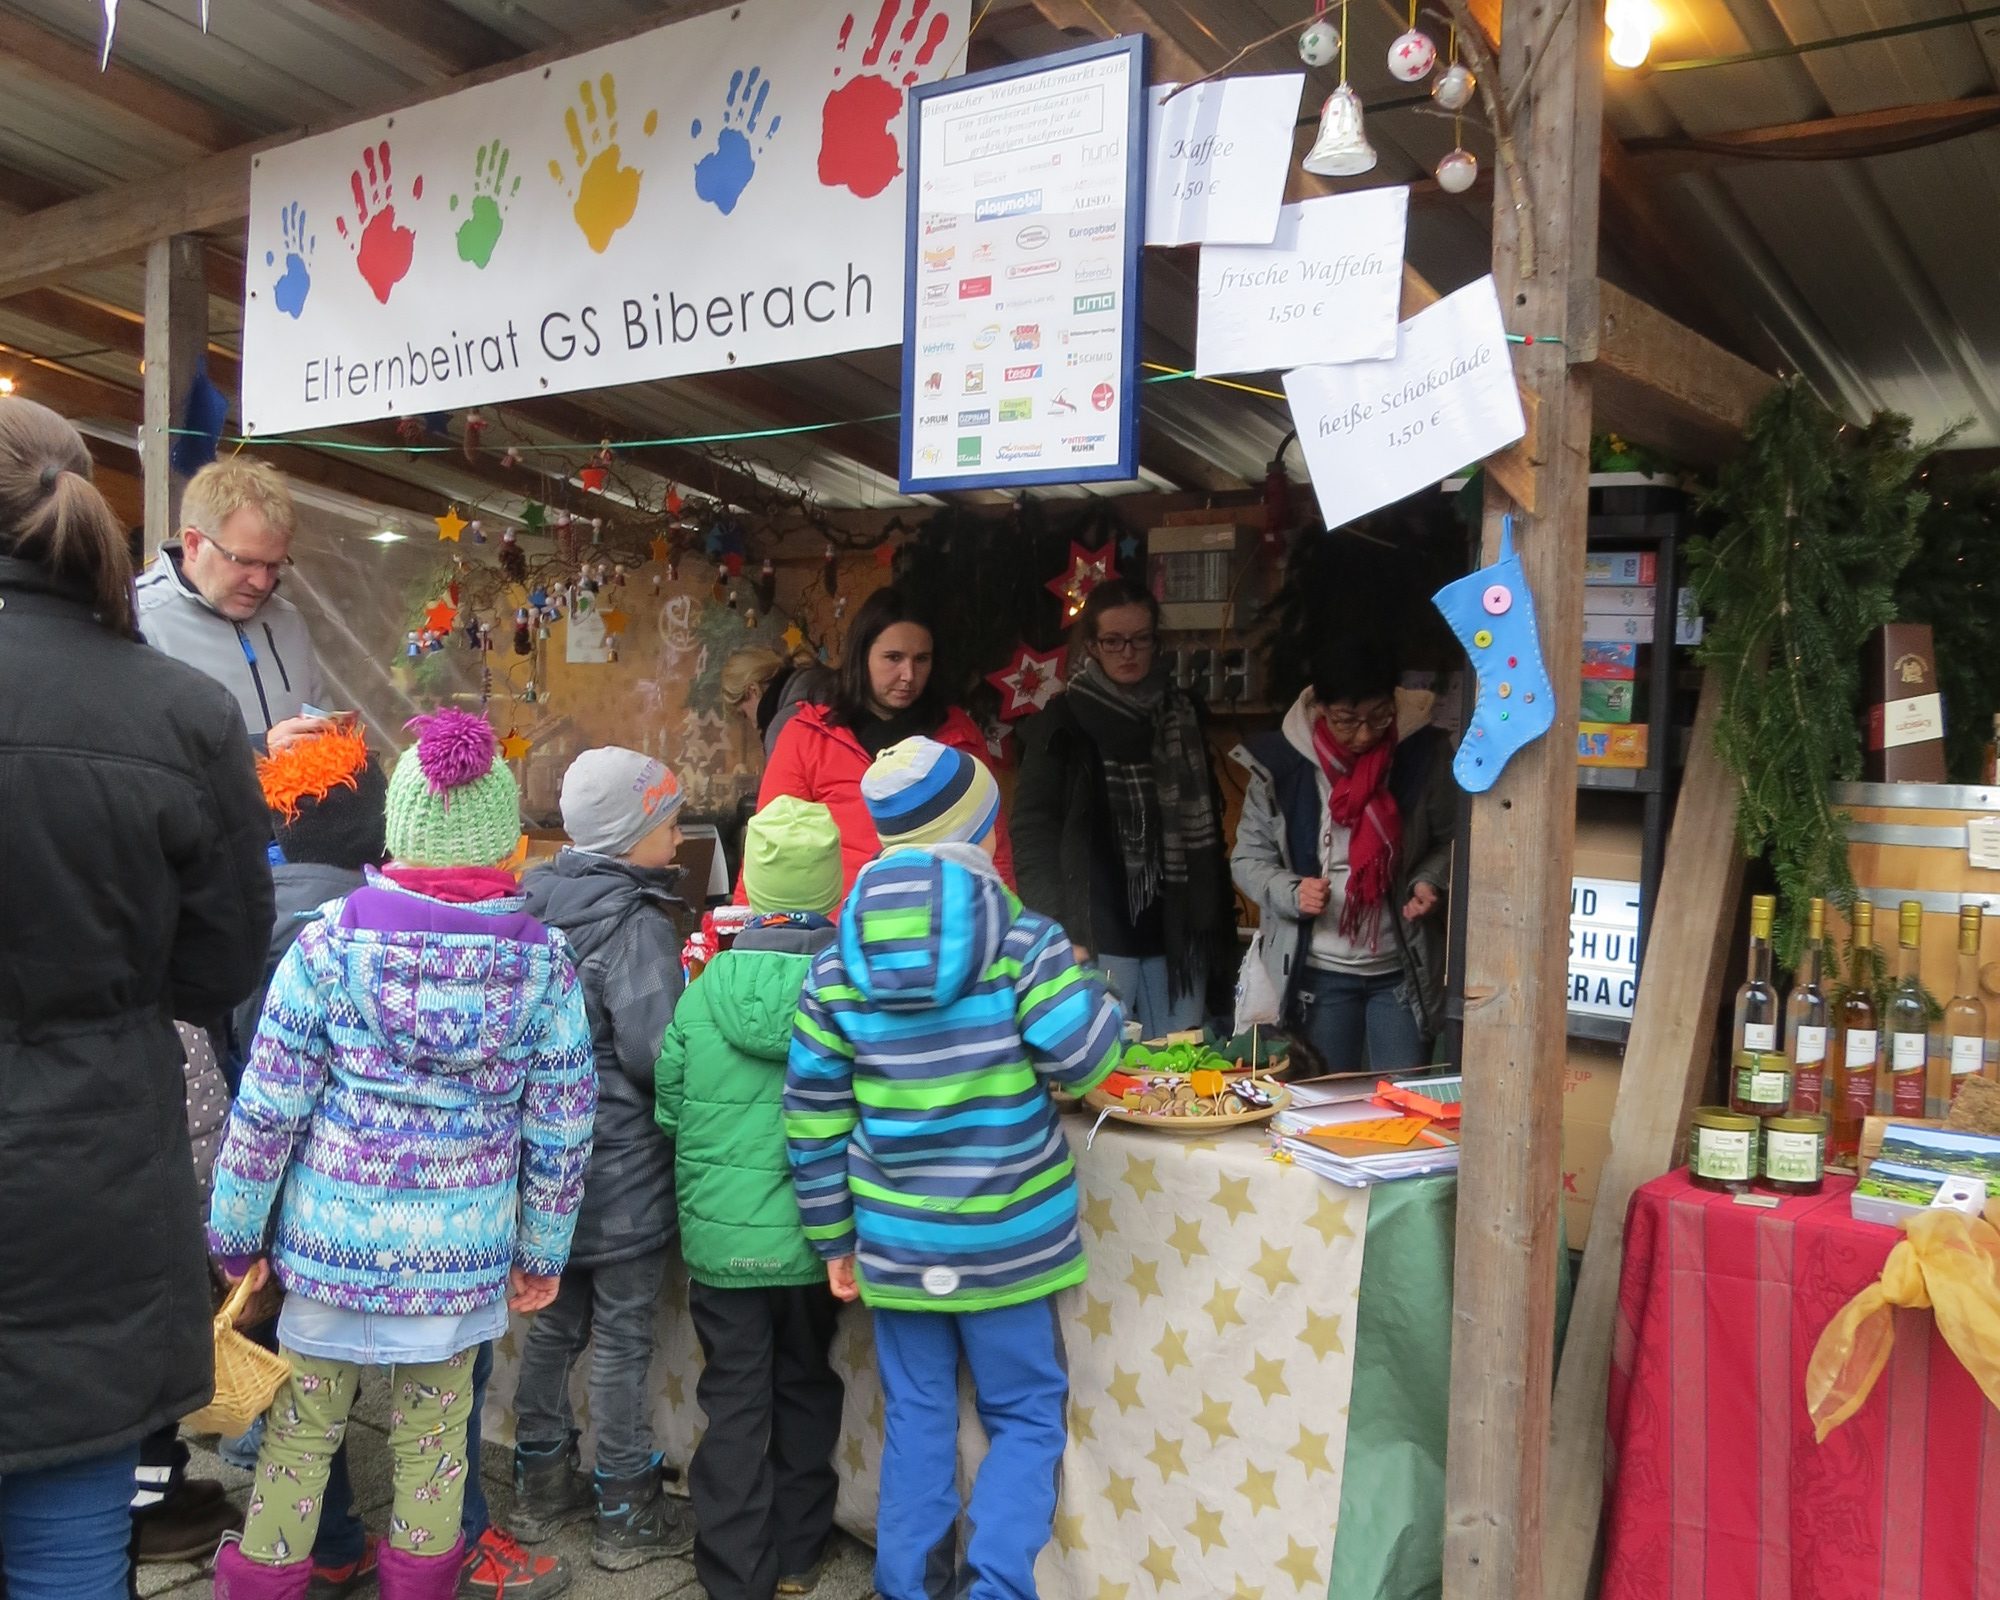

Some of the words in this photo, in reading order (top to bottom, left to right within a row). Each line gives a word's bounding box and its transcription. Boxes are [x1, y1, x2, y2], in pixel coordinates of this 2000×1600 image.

[991, 66, 1095, 100] Weihnachtsmarkt
[1099, 61, 1126, 77] 2018
[1081, 137, 1119, 161] hund
[1170, 134, 1234, 167] Kaffee
[1173, 180, 1204, 200] 1,50
[1208, 180, 1220, 195] €
[977, 191, 1040, 219] playmobil
[1069, 222, 1116, 238] Europabad
[1212, 263, 1288, 297] frische
[1297, 252, 1383, 287] Waffeln
[1268, 303, 1305, 323] 1,50
[1312, 301, 1325, 316] €
[304, 320, 519, 403] Elternbeirat
[541, 306, 601, 361] GS
[623, 264, 871, 350] Biberach
[1079, 353, 1112, 364] SCHMID
[1006, 368, 1031, 380] tesa
[1319, 403, 1373, 438] heiße
[1380, 343, 1490, 414] Schokolade
[919, 414, 948, 425] FORUM
[1388, 420, 1424, 448] 1,50
[1431, 410, 1441, 426] €
[1574, 1071, 1592, 1081] UP
